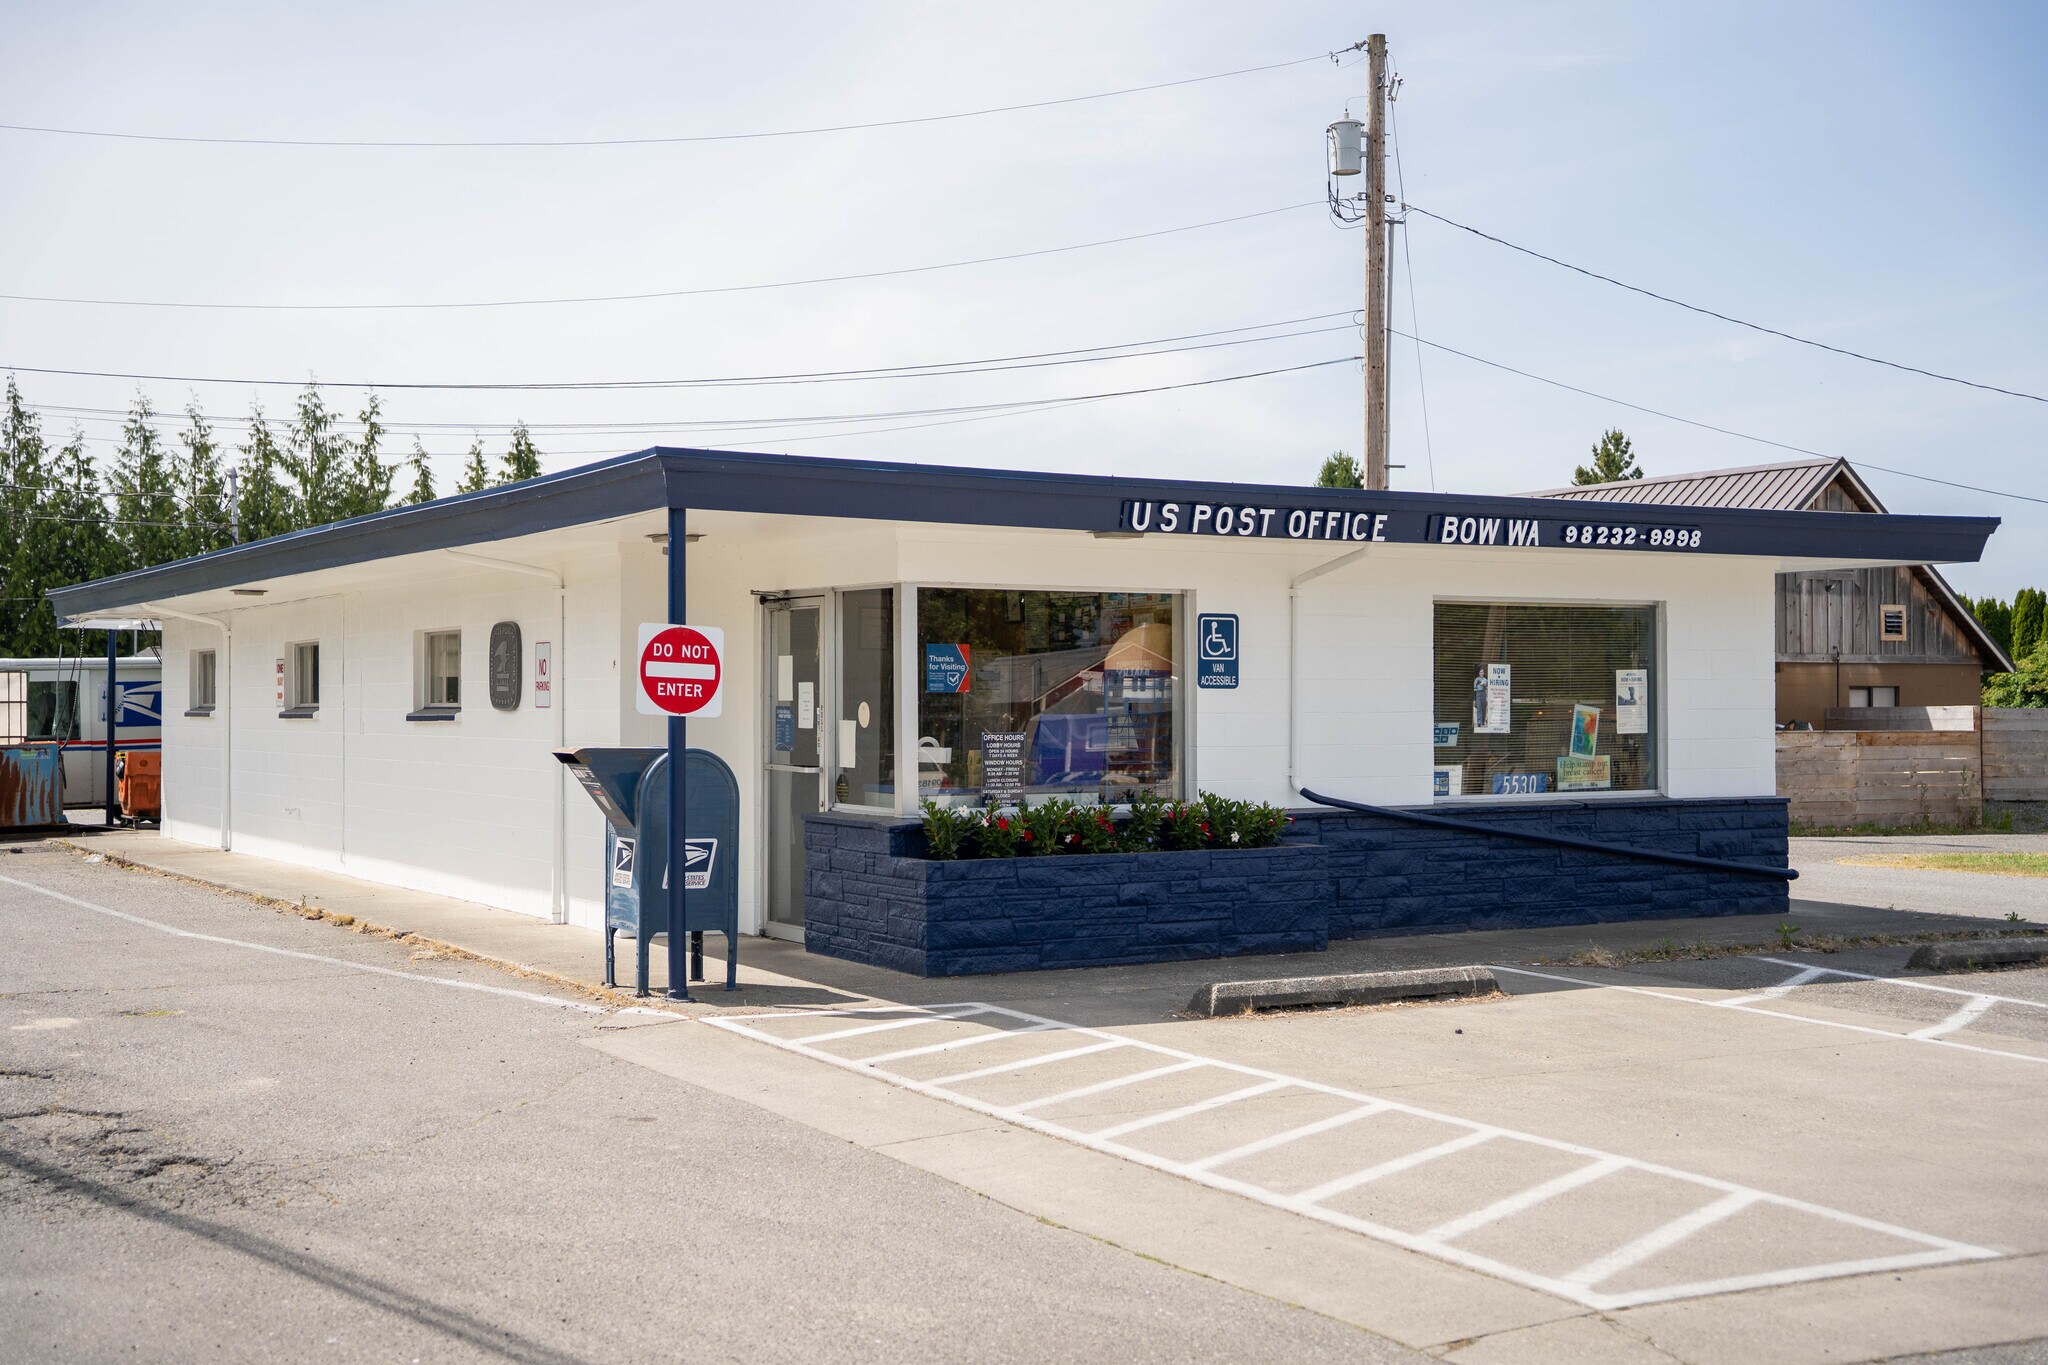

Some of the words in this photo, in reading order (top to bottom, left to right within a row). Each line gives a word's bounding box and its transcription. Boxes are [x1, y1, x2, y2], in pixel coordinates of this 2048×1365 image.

[1192, 505, 1276, 537] POST
[1288, 510, 1389, 542] OFFICE
[1441, 516, 1501, 545] BOW
[1508, 520, 1539, 547] WA
[1565, 526, 1702, 548] 98232-9998
[653, 643, 673, 657] DO
[681, 645, 710, 659] NOT
[538, 658, 547, 676] NO
[940, 663, 966, 672] Visiting
[1212, 663, 1225, 673] VAN
[1492, 667, 1506, 675] NOW
[536, 681, 550, 691] PARKING
[1200, 675, 1236, 686] ACCESSIBLE
[1489, 679, 1509, 687] HIRING
[657, 682, 703, 698] ENTER
[1560, 760, 1575, 770] Help
[1577, 760, 1595, 769] stamp
[1597, 760, 1608, 768] out
[1563, 769, 1581, 777] breast
[1503, 775, 1537, 794] 5530
